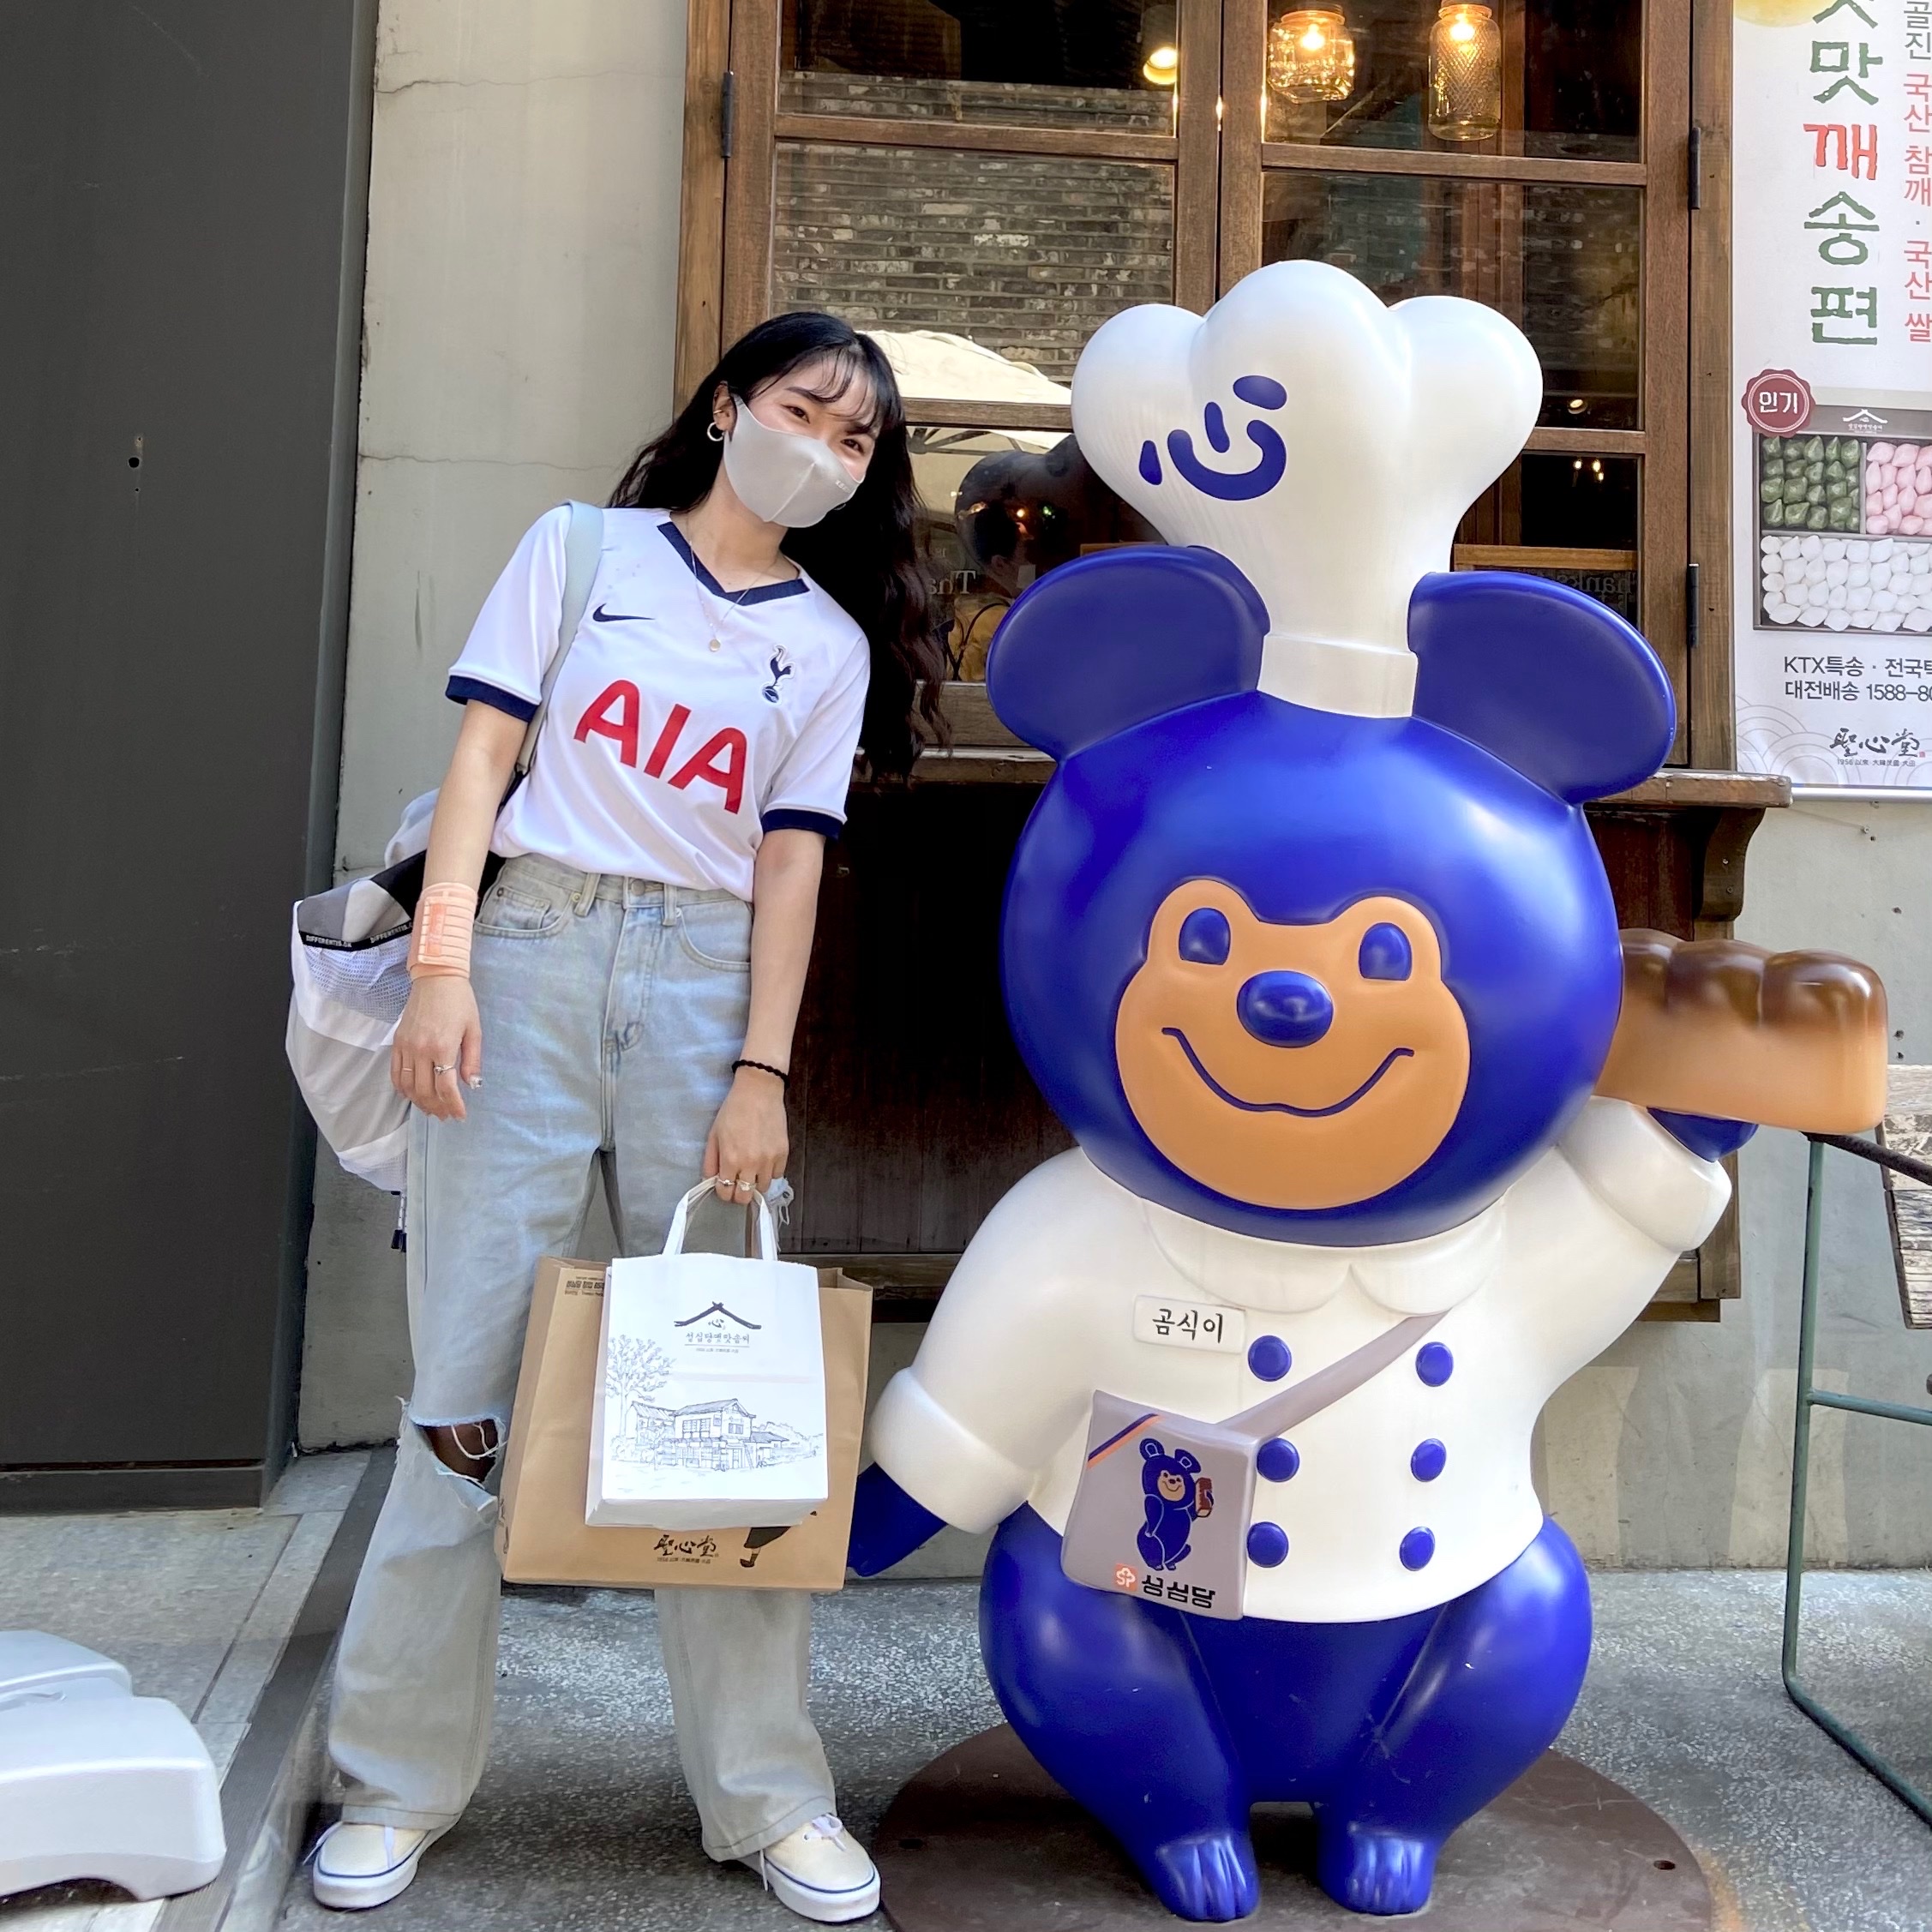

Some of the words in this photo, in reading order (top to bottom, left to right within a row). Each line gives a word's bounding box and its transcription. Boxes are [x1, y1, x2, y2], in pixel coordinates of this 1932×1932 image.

[1904, 145, 1932, 207] 참깨
[1760, 392, 1797, 414] 인기
[1784, 657, 1865, 677] KTX특송
[1785, 681, 1859, 700] 대전배송
[573, 680, 747, 814] AIA
[1152, 1308, 1223, 1344] 곰식이
[1142, 1575, 1215, 1609] 성심당
